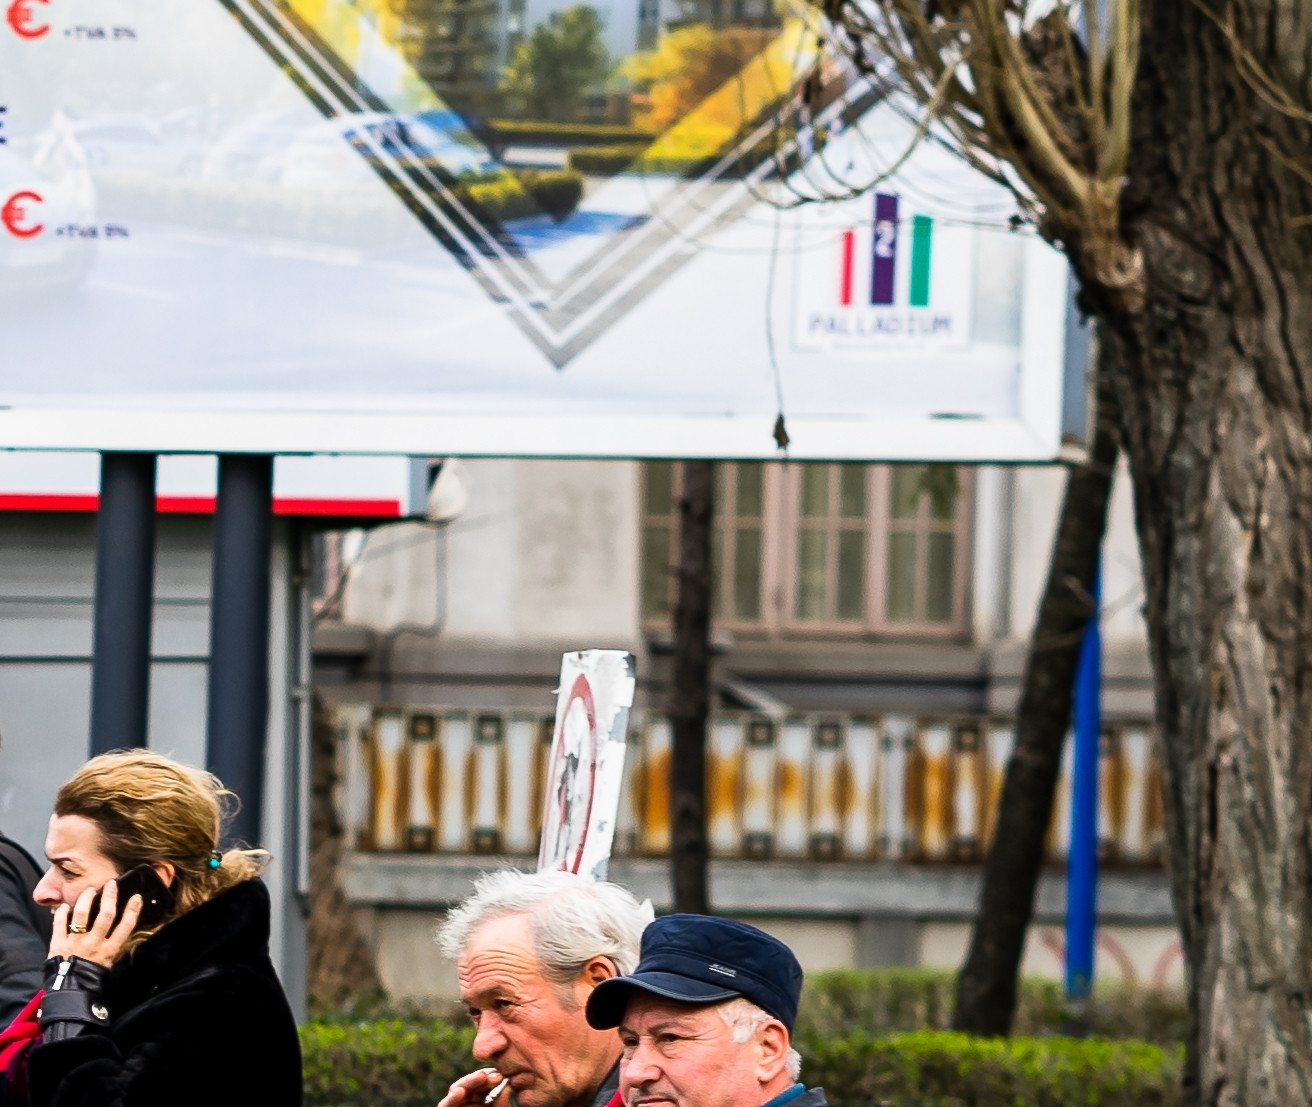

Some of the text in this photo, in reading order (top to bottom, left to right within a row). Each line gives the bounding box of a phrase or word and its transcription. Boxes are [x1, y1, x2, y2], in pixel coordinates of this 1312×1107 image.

[6, 0, 51, 38] €
[1, 191, 45, 238] €
[876, 221, 895, 258] 2
[808, 313, 952, 335] PALLADIUM
